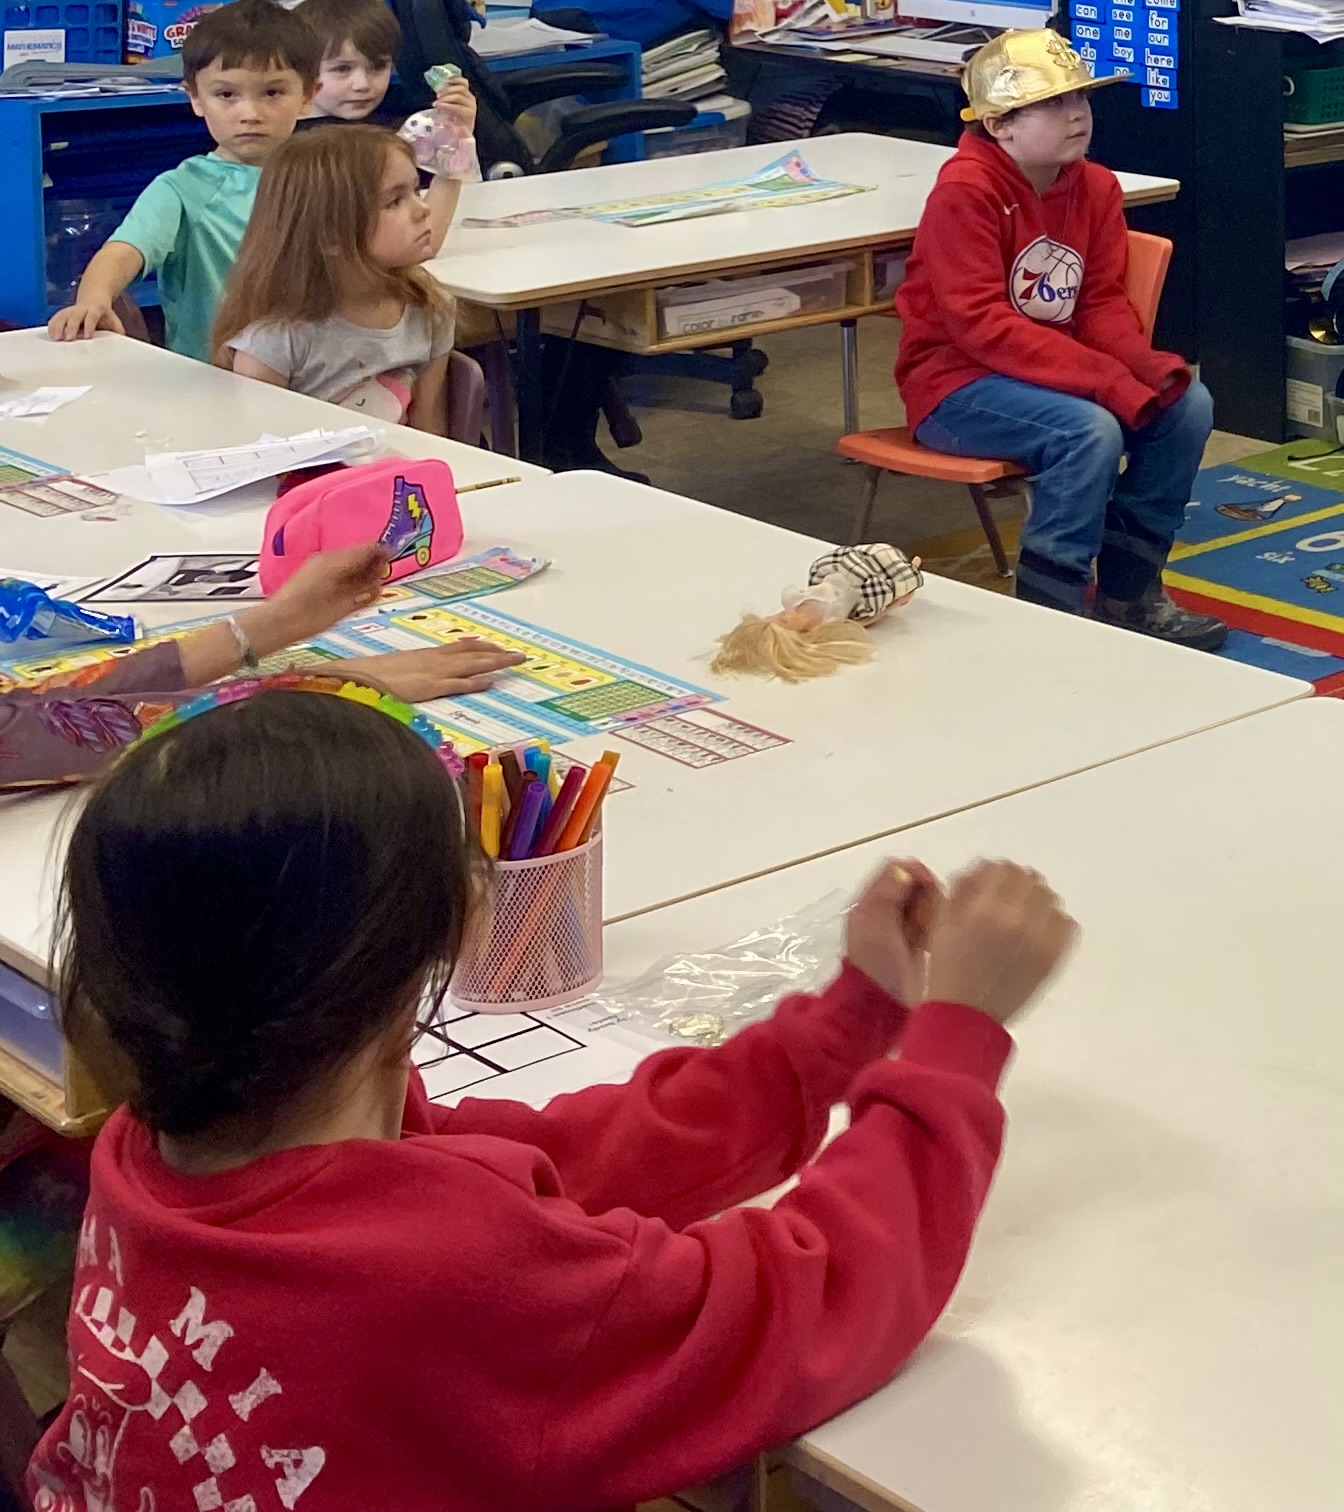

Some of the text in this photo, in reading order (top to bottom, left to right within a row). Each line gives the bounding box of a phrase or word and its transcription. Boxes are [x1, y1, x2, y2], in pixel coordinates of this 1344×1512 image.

[1077, 6, 1096, 16] can
[1114, 45, 1132, 60] boy
[1146, 52, 1173, 66] here
[1147, 69, 1168, 84] like
[1151, 91, 1169, 104] you
[1019, 268, 1078, 302] 76er
[1217, 474, 1287, 495] yacht
